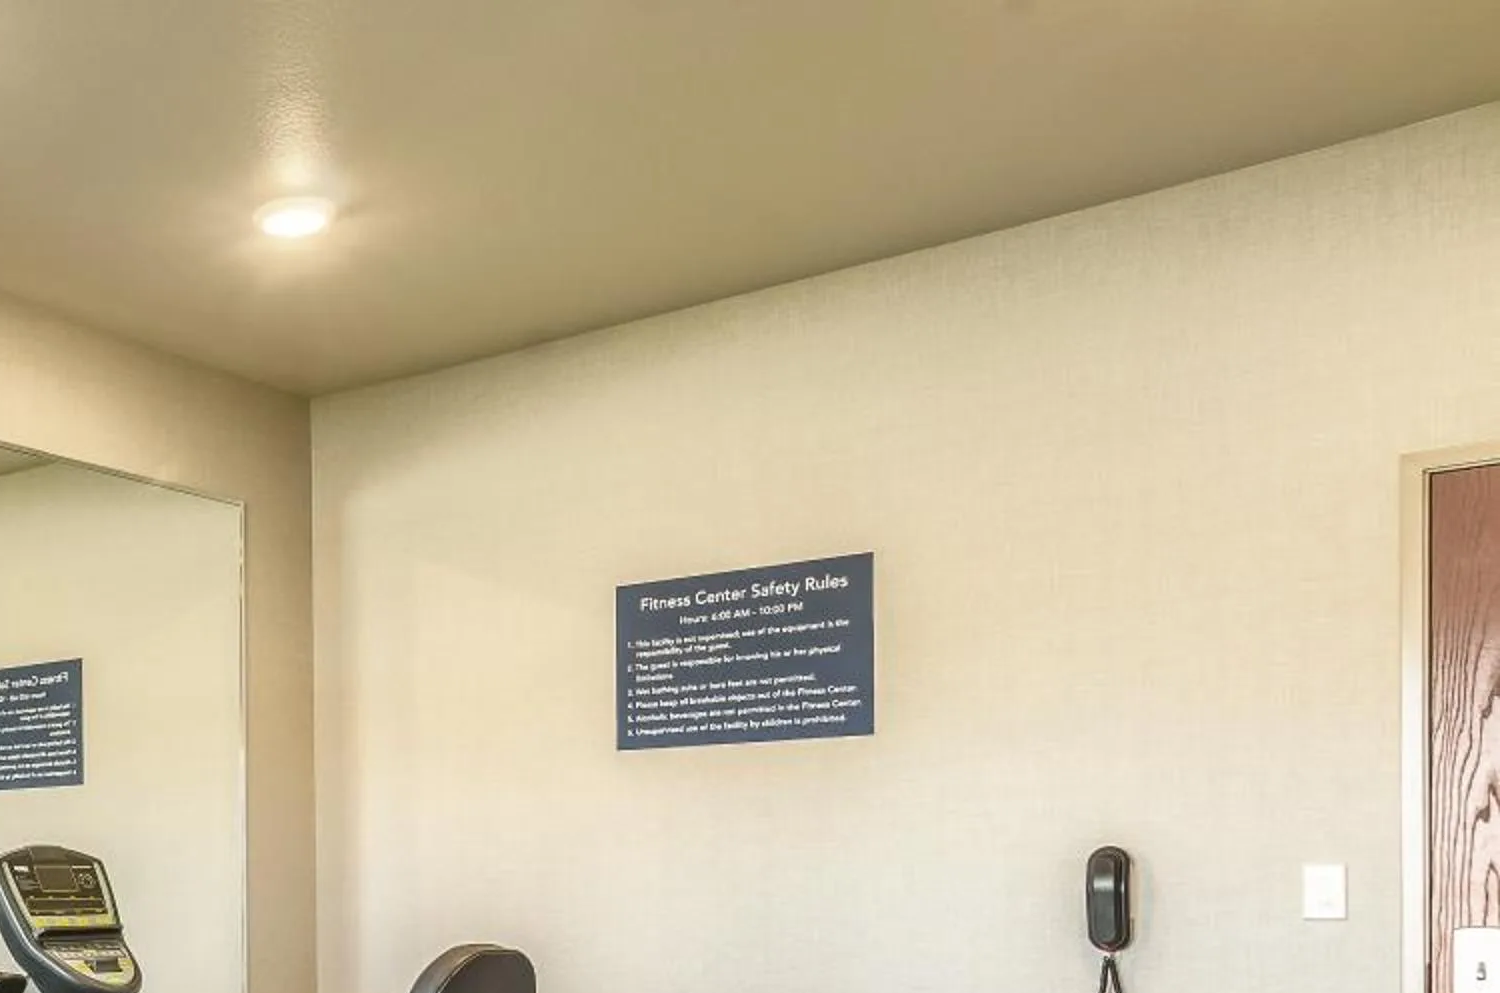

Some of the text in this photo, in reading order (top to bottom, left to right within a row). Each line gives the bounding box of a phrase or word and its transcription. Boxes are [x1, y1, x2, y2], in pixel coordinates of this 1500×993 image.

[640, 573, 849, 612] Fitness Center Safety Rules
[733, 607, 751, 619] AM
[788, 602, 804, 612] PM
[797, 687, 827, 697] Fitness
[801, 701, 831, 711] Fitness
